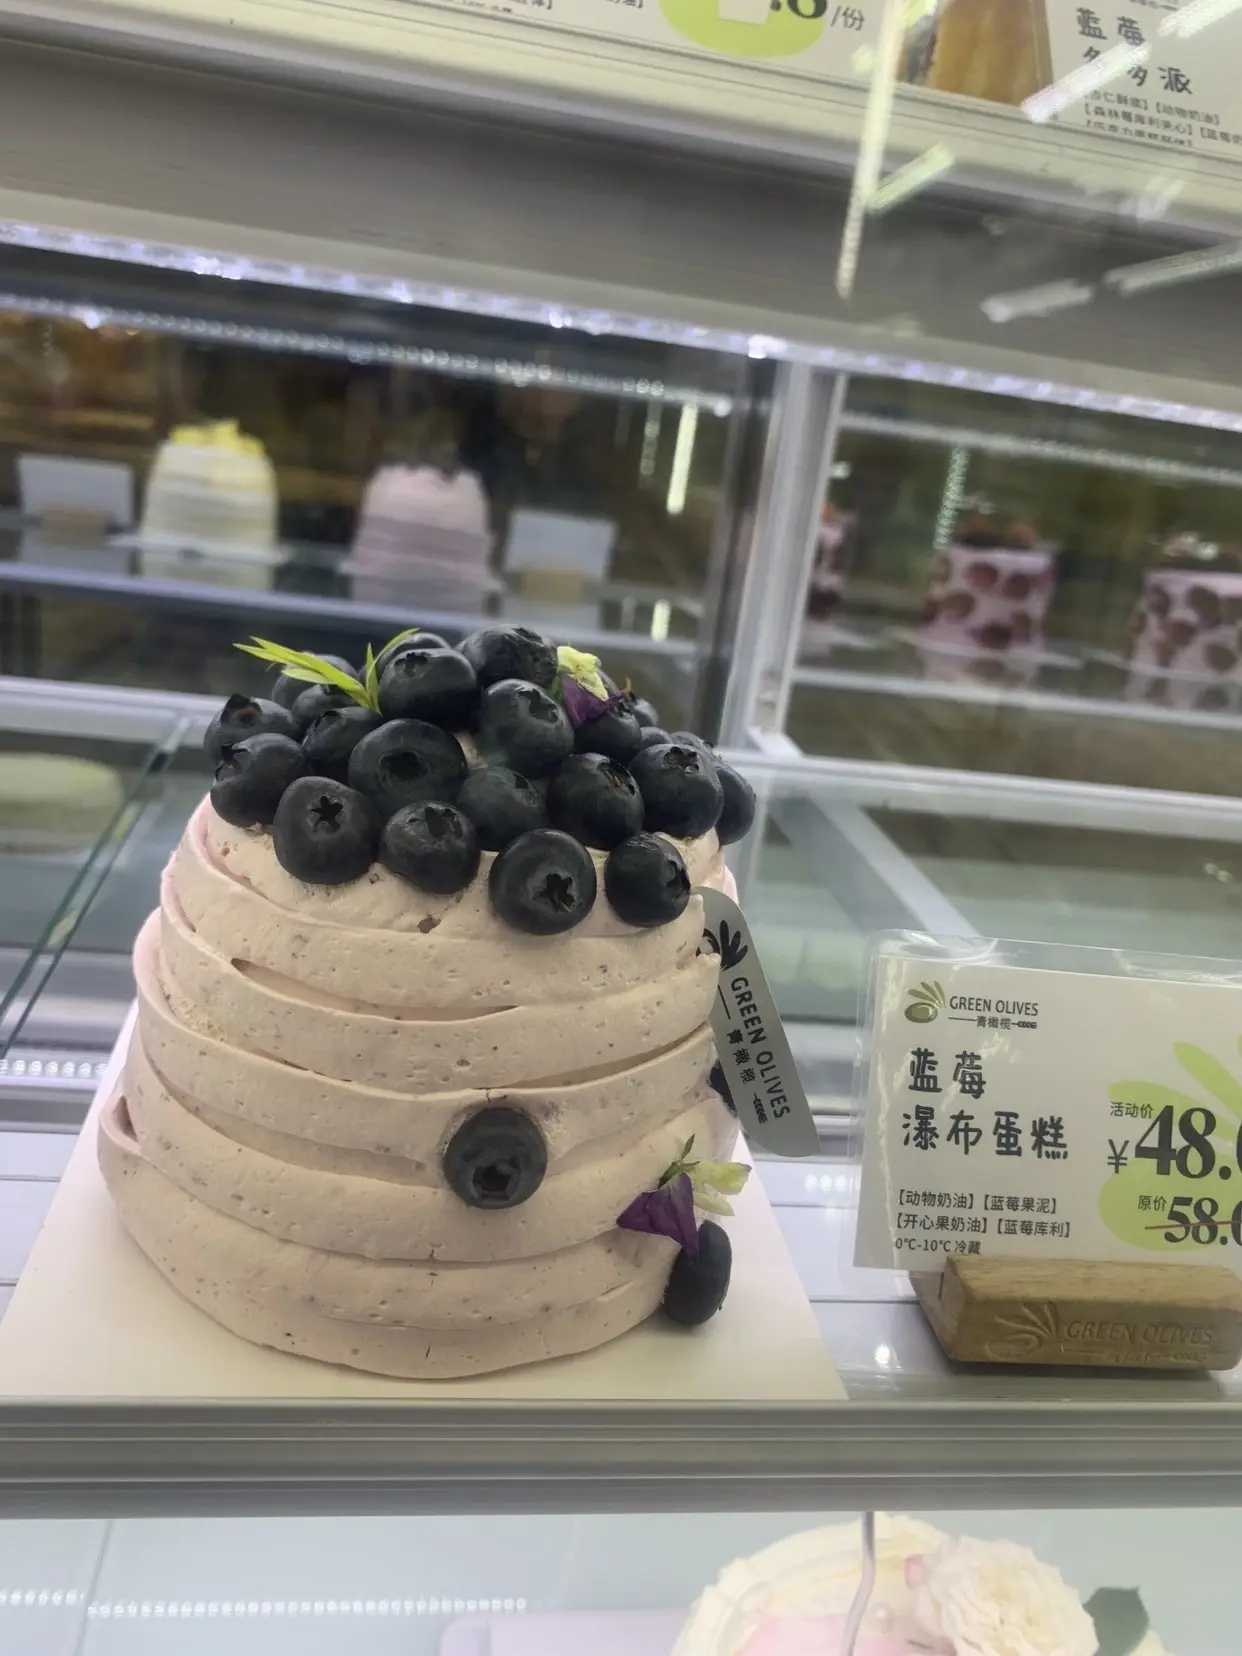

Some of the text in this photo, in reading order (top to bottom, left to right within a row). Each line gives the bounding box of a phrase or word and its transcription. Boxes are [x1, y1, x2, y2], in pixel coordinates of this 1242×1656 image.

[1076, 7, 1147, 47] 蓝莓
[949, 995, 1039, 1016] GREEN OLIVES
[976, 1015, 1012, 1030] 青橄榄
[730, 976, 791, 1119] GREEN OLIVES
[908, 1047, 986, 1099] 蓝莓
[1109, 1101, 1154, 1119] 活动价
[901, 1104, 1069, 1160] 瀑布蛋糕
[1107, 1104, 1242, 1181] ¥48.
[1137, 1195, 1168, 1212] 原价
[954, 1240, 981, 1255] 冷藏
[1066, 1320, 1213, 1345] GREEN OLIVES
